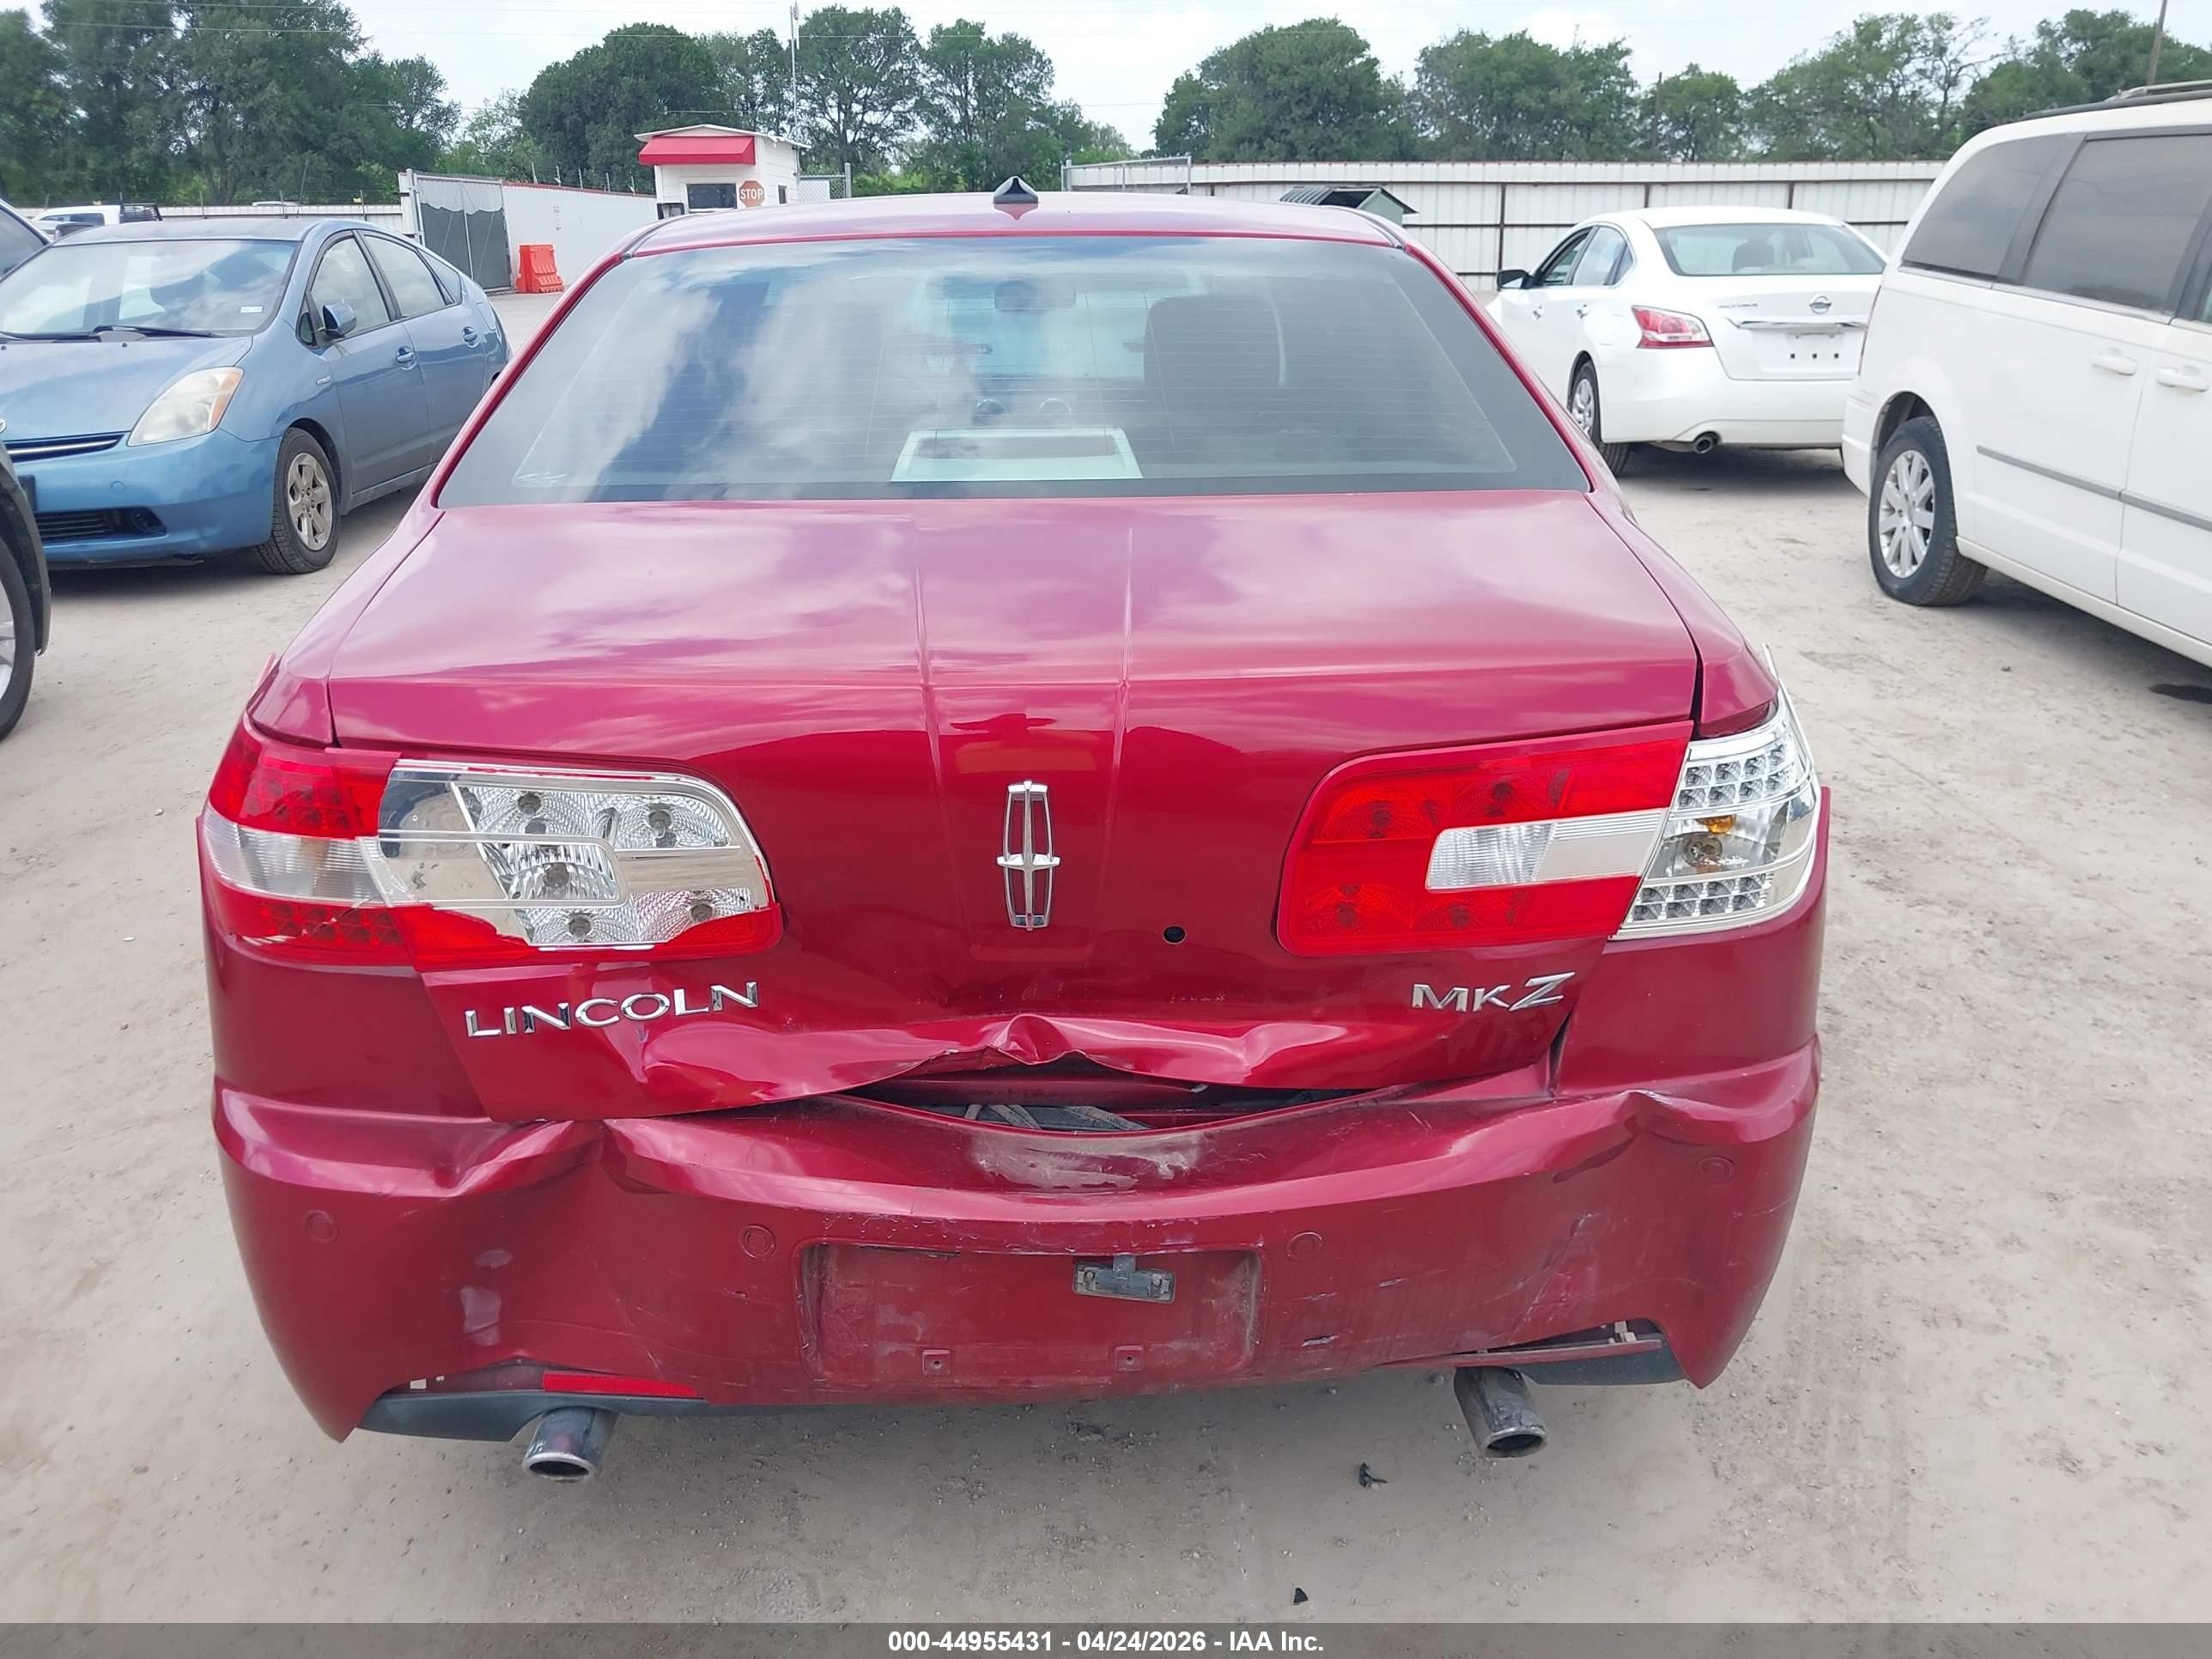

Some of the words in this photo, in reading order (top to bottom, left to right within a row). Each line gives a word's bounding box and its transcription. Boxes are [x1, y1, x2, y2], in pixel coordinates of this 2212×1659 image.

[740, 188, 763, 199] STOP
[465, 981, 759, 1037] LINCOLN
[1411, 971, 1576, 1012] MKZ
